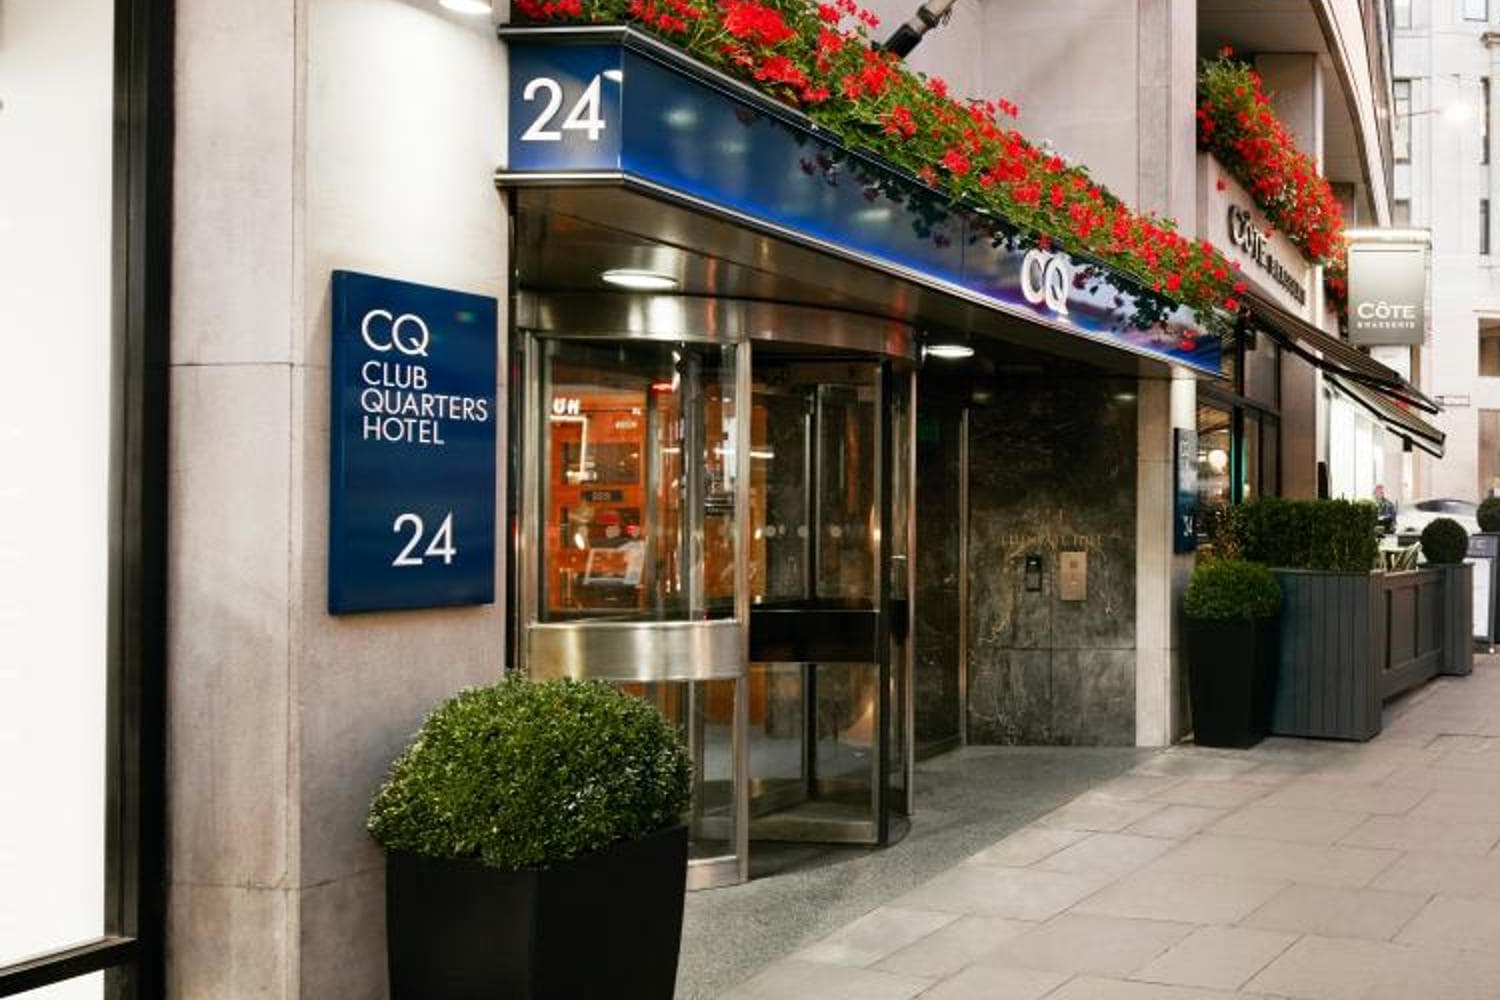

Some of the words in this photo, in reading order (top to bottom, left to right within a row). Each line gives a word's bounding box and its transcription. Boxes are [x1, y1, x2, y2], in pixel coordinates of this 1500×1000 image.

[520, 75, 606, 141] 24
[1021, 248, 1069, 315] CQ
[1357, 301, 1416, 319] CÔTE
[361, 309, 429, 357] CQ
[361, 360, 427, 390] CLUB
[361, 388, 488, 422] QUARTERS
[362, 416, 445, 445] HOTEL
[391, 512, 456, 566] 24
